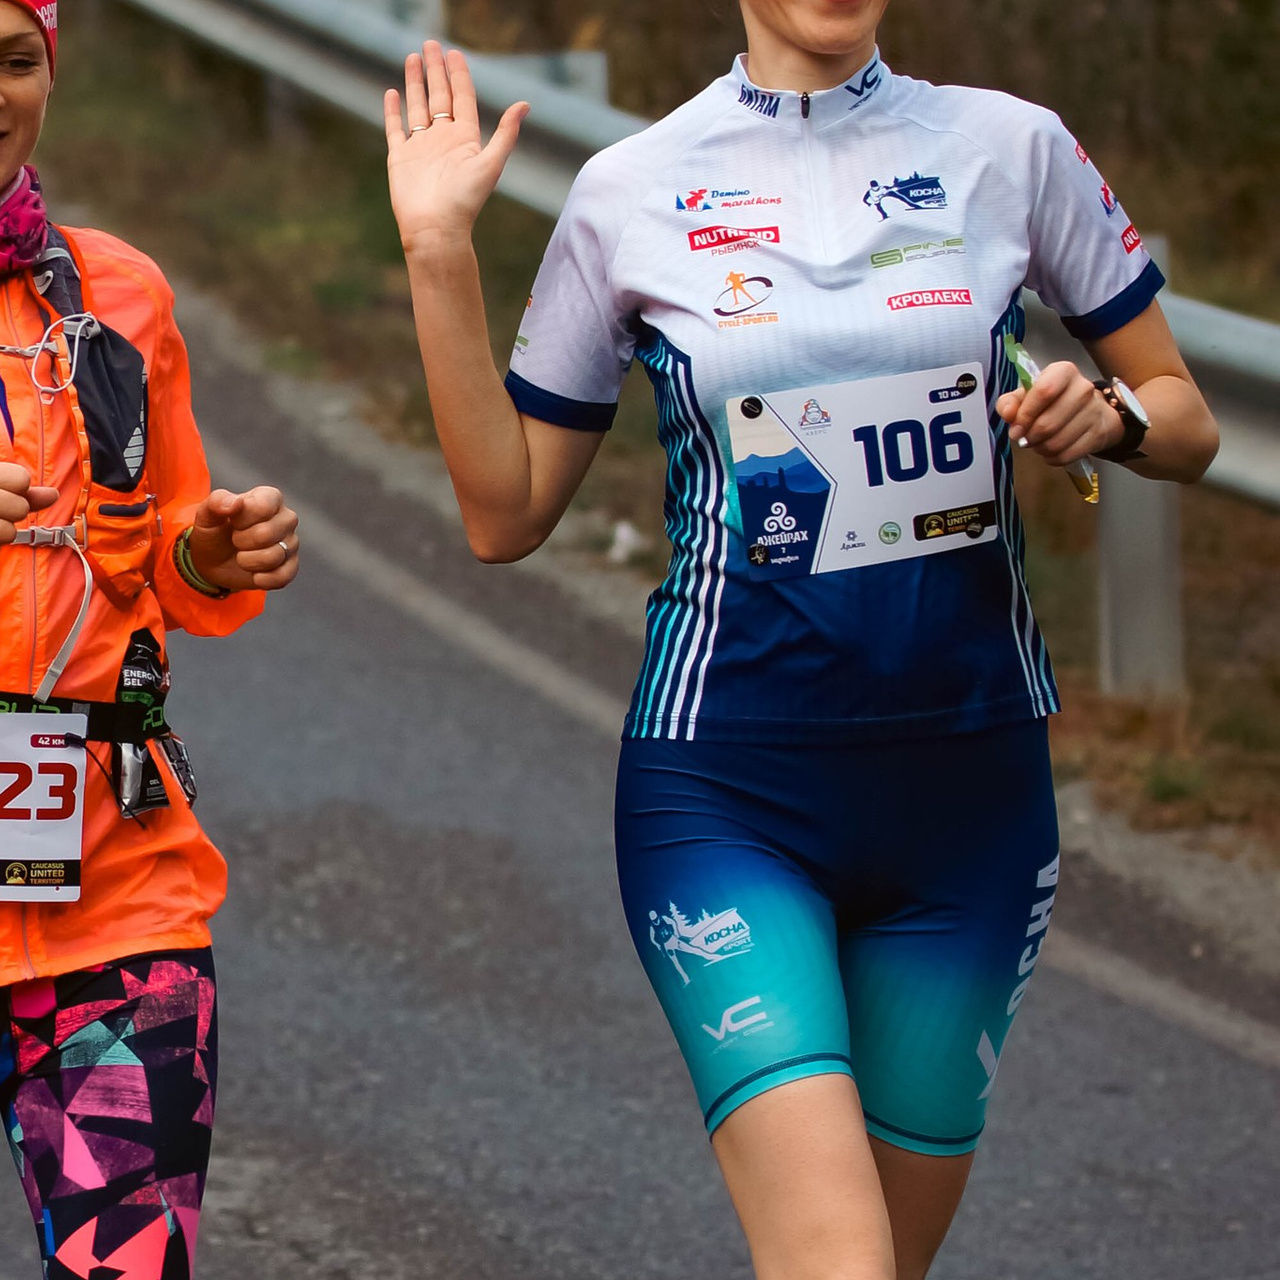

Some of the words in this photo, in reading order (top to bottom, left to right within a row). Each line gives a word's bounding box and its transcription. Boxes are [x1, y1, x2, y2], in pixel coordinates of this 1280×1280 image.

[711, 189, 751, 198] Demino
[721, 196, 782, 209] marathons
[693, 228, 776, 247] NUTREND
[711, 240, 761, 257] РЫБИНСК
[891, 291, 970, 309] КРОВЛЕКС
[957, 380, 976, 388] RUN
[938, 390, 949, 400] 10
[852, 410, 975, 488] 106
[123, 678, 143, 687] GEL
[37, 736, 51, 746] 42
[703, 921, 746, 946] KOCHA
